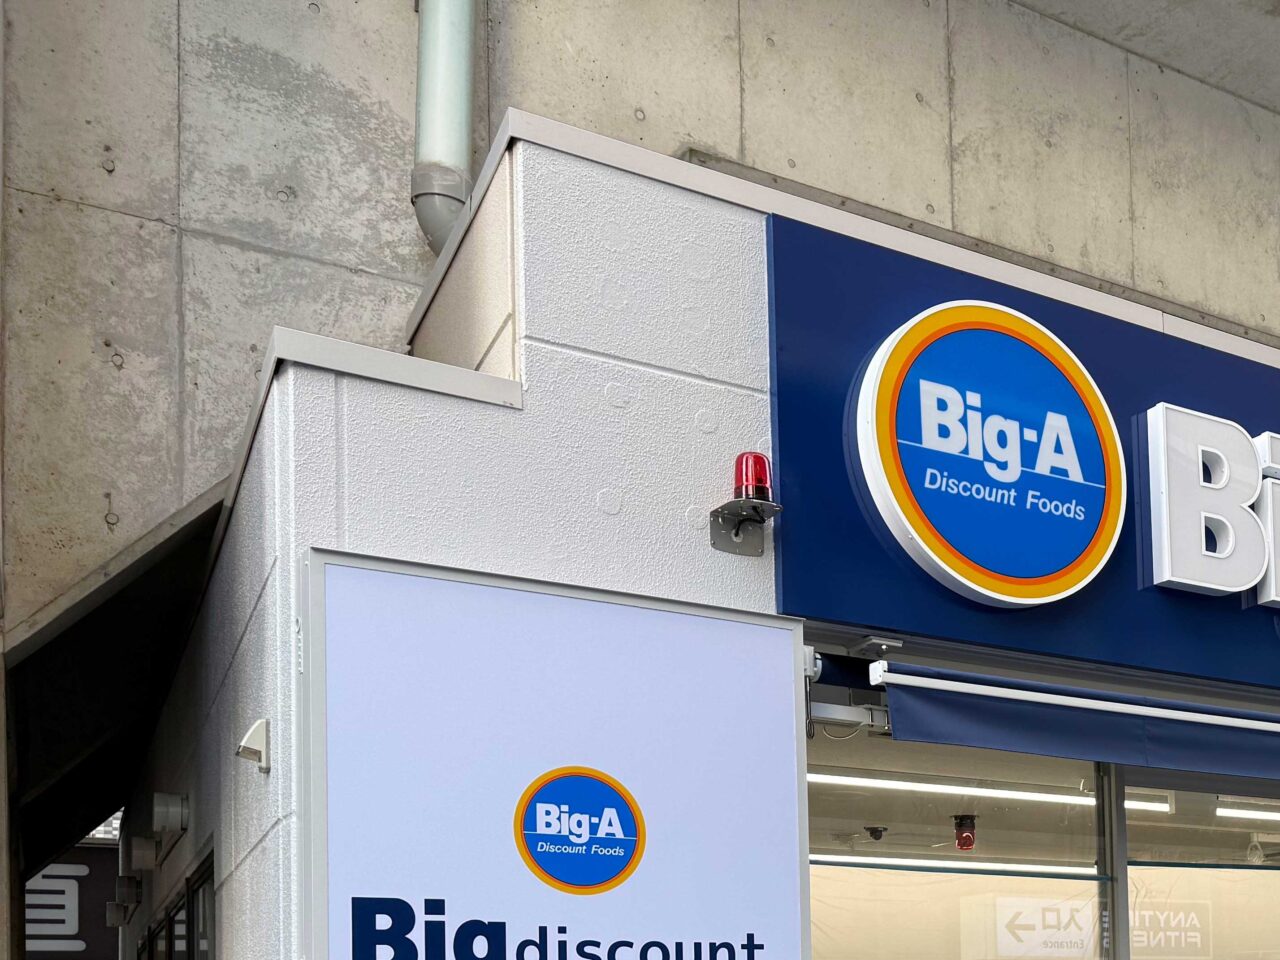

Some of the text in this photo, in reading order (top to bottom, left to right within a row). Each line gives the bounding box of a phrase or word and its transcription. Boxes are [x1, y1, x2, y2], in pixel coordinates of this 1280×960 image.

[919, 379, 1084, 483] Big-A
[924, 468, 1086, 520] Discount Foods
[536, 802, 625, 844] Big-A
[537, 842, 625, 856] Discount Foods
